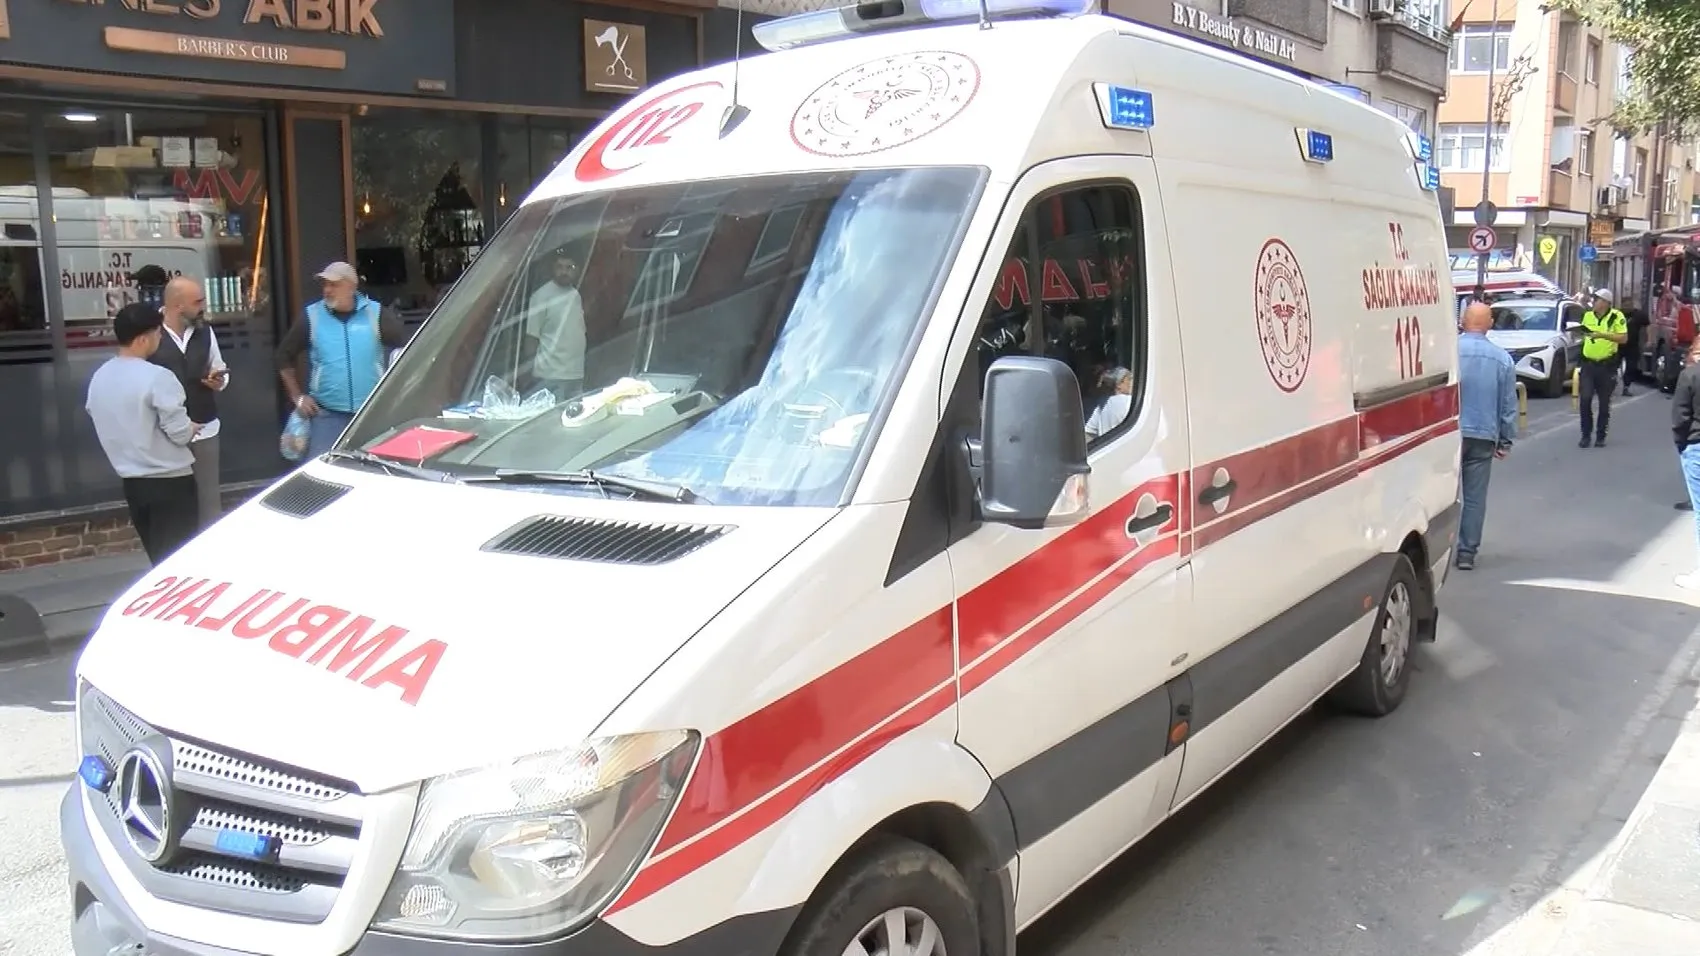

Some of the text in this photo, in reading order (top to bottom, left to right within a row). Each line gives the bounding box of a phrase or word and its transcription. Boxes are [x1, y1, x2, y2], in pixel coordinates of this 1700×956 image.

[177, 38, 288, 61] BARBER'S CLUB
[1172, 2, 1296, 61] B.Y Beauty & Nail Art
[613, 102, 704, 151] 112
[1362, 260, 1399, 310] SAĞLIK
[1395, 316, 1423, 380] 112
